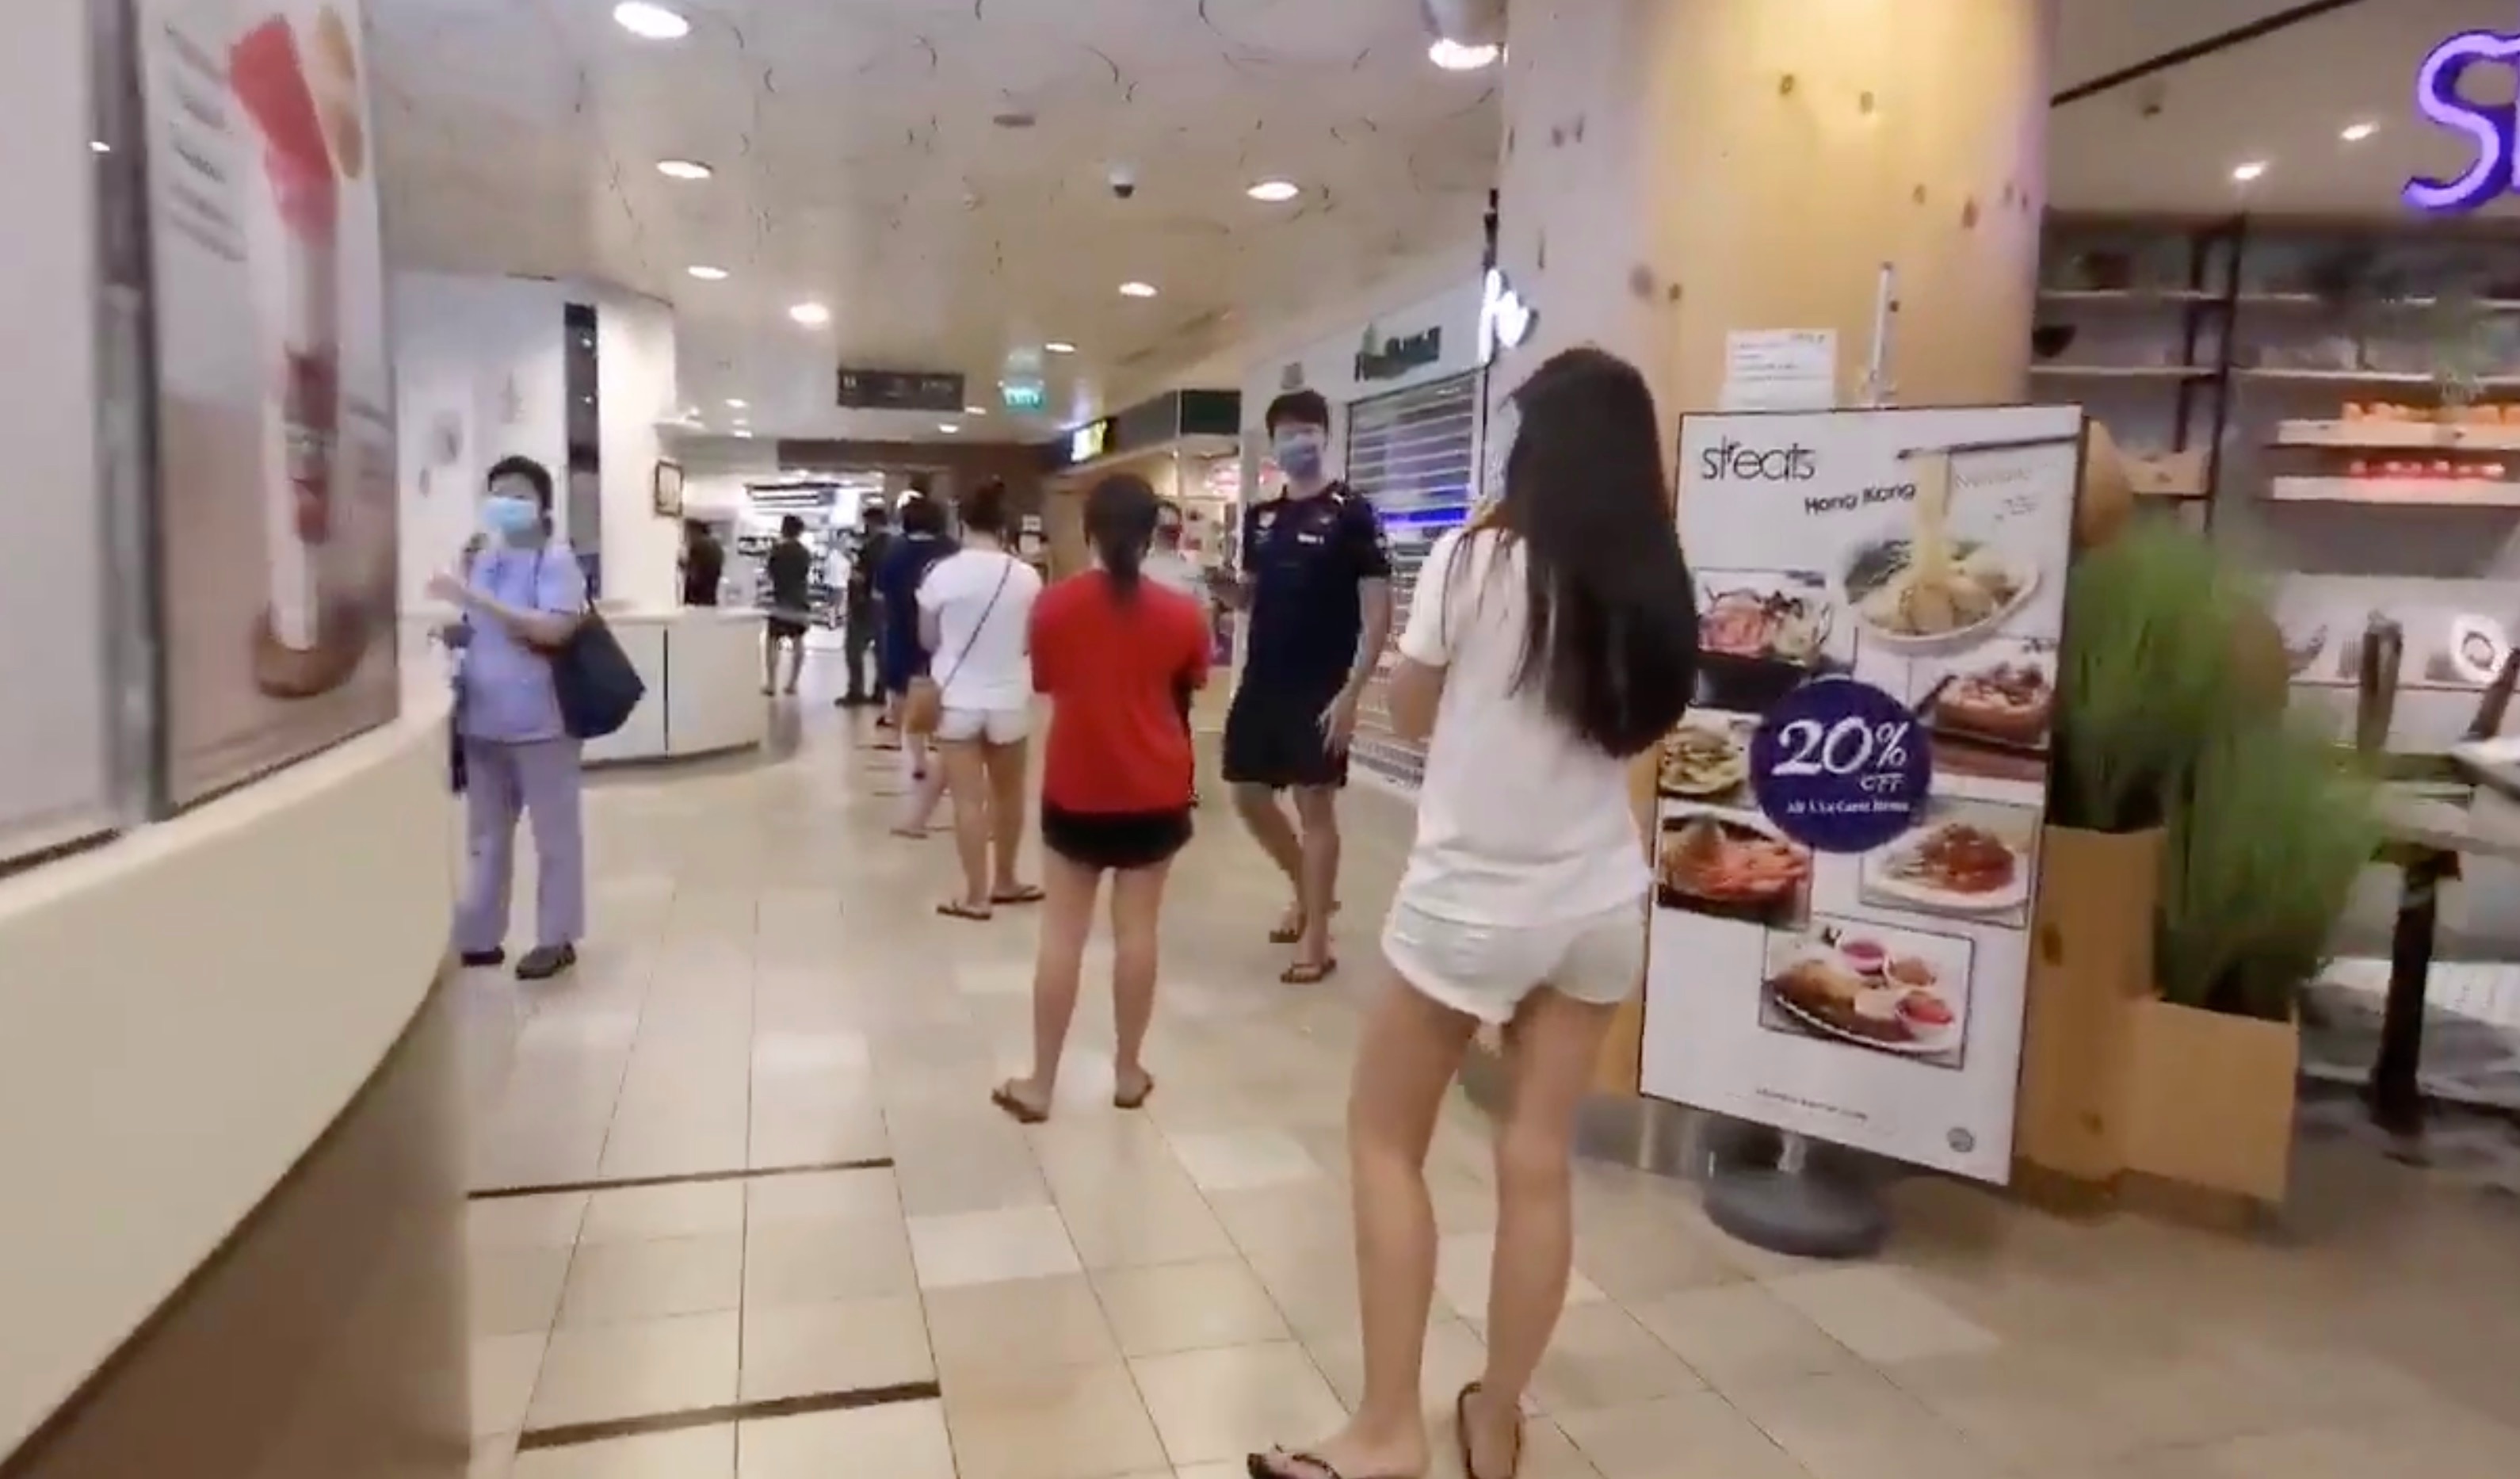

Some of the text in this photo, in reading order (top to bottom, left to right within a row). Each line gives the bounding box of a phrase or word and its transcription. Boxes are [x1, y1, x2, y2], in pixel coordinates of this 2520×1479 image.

[1804, 481, 1916, 515] Hong Kong
[1771, 717, 1910, 777] 20%
[1861, 773, 1904, 793] OFF
